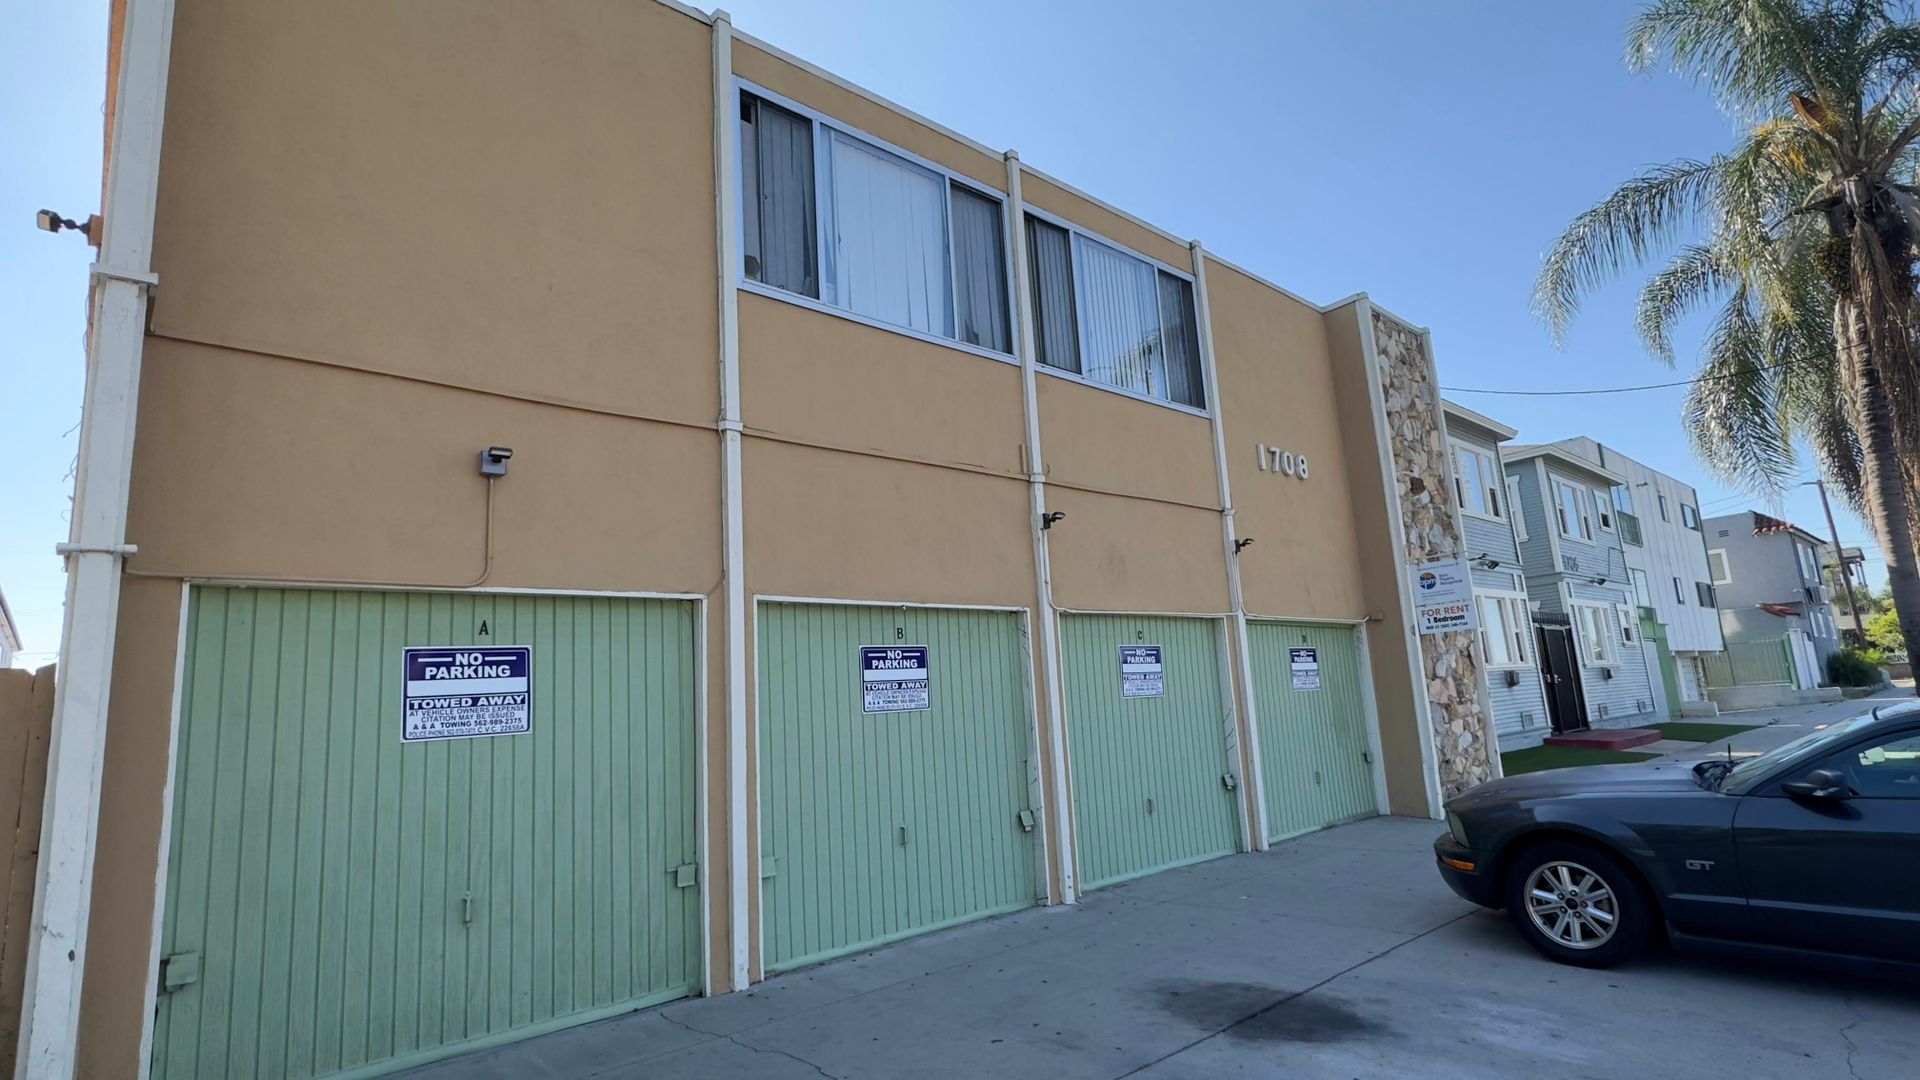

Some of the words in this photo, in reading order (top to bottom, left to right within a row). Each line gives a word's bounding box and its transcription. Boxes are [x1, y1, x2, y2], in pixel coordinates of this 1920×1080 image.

[1256, 443, 1308, 480] 1708
[1421, 608, 1441, 617] FOR
[1444, 604, 1470, 614] RENT
[1433, 614, 1465, 623] Bedroom
[478, 619, 489, 635] A
[897, 627, 904, 640] B
[1137, 630, 1143, 640] C
[887, 650, 902, 659] NO
[1135, 648, 1146, 656] NO
[455, 653, 483, 665] NO
[872, 659, 918, 669] PARKING
[1127, 656, 1156, 664] PARKING
[425, 665, 511, 680] PARKING
[866, 682, 899, 690] TOWED
[901, 681, 926, 689] AWAY
[411, 698, 472, 710] TOWED
[477, 695, 525, 706] AWAY
[421, 709, 455, 717] VEHICLE
[457, 706, 490, 715] OWNERS
[492, 704, 524, 712] EXPENSE
[421, 715, 457, 723] CITATION
[488, 711, 515, 719] ISSUED
[441, 720, 472, 729] TOWING
[1685, 859, 1715, 870] GT
